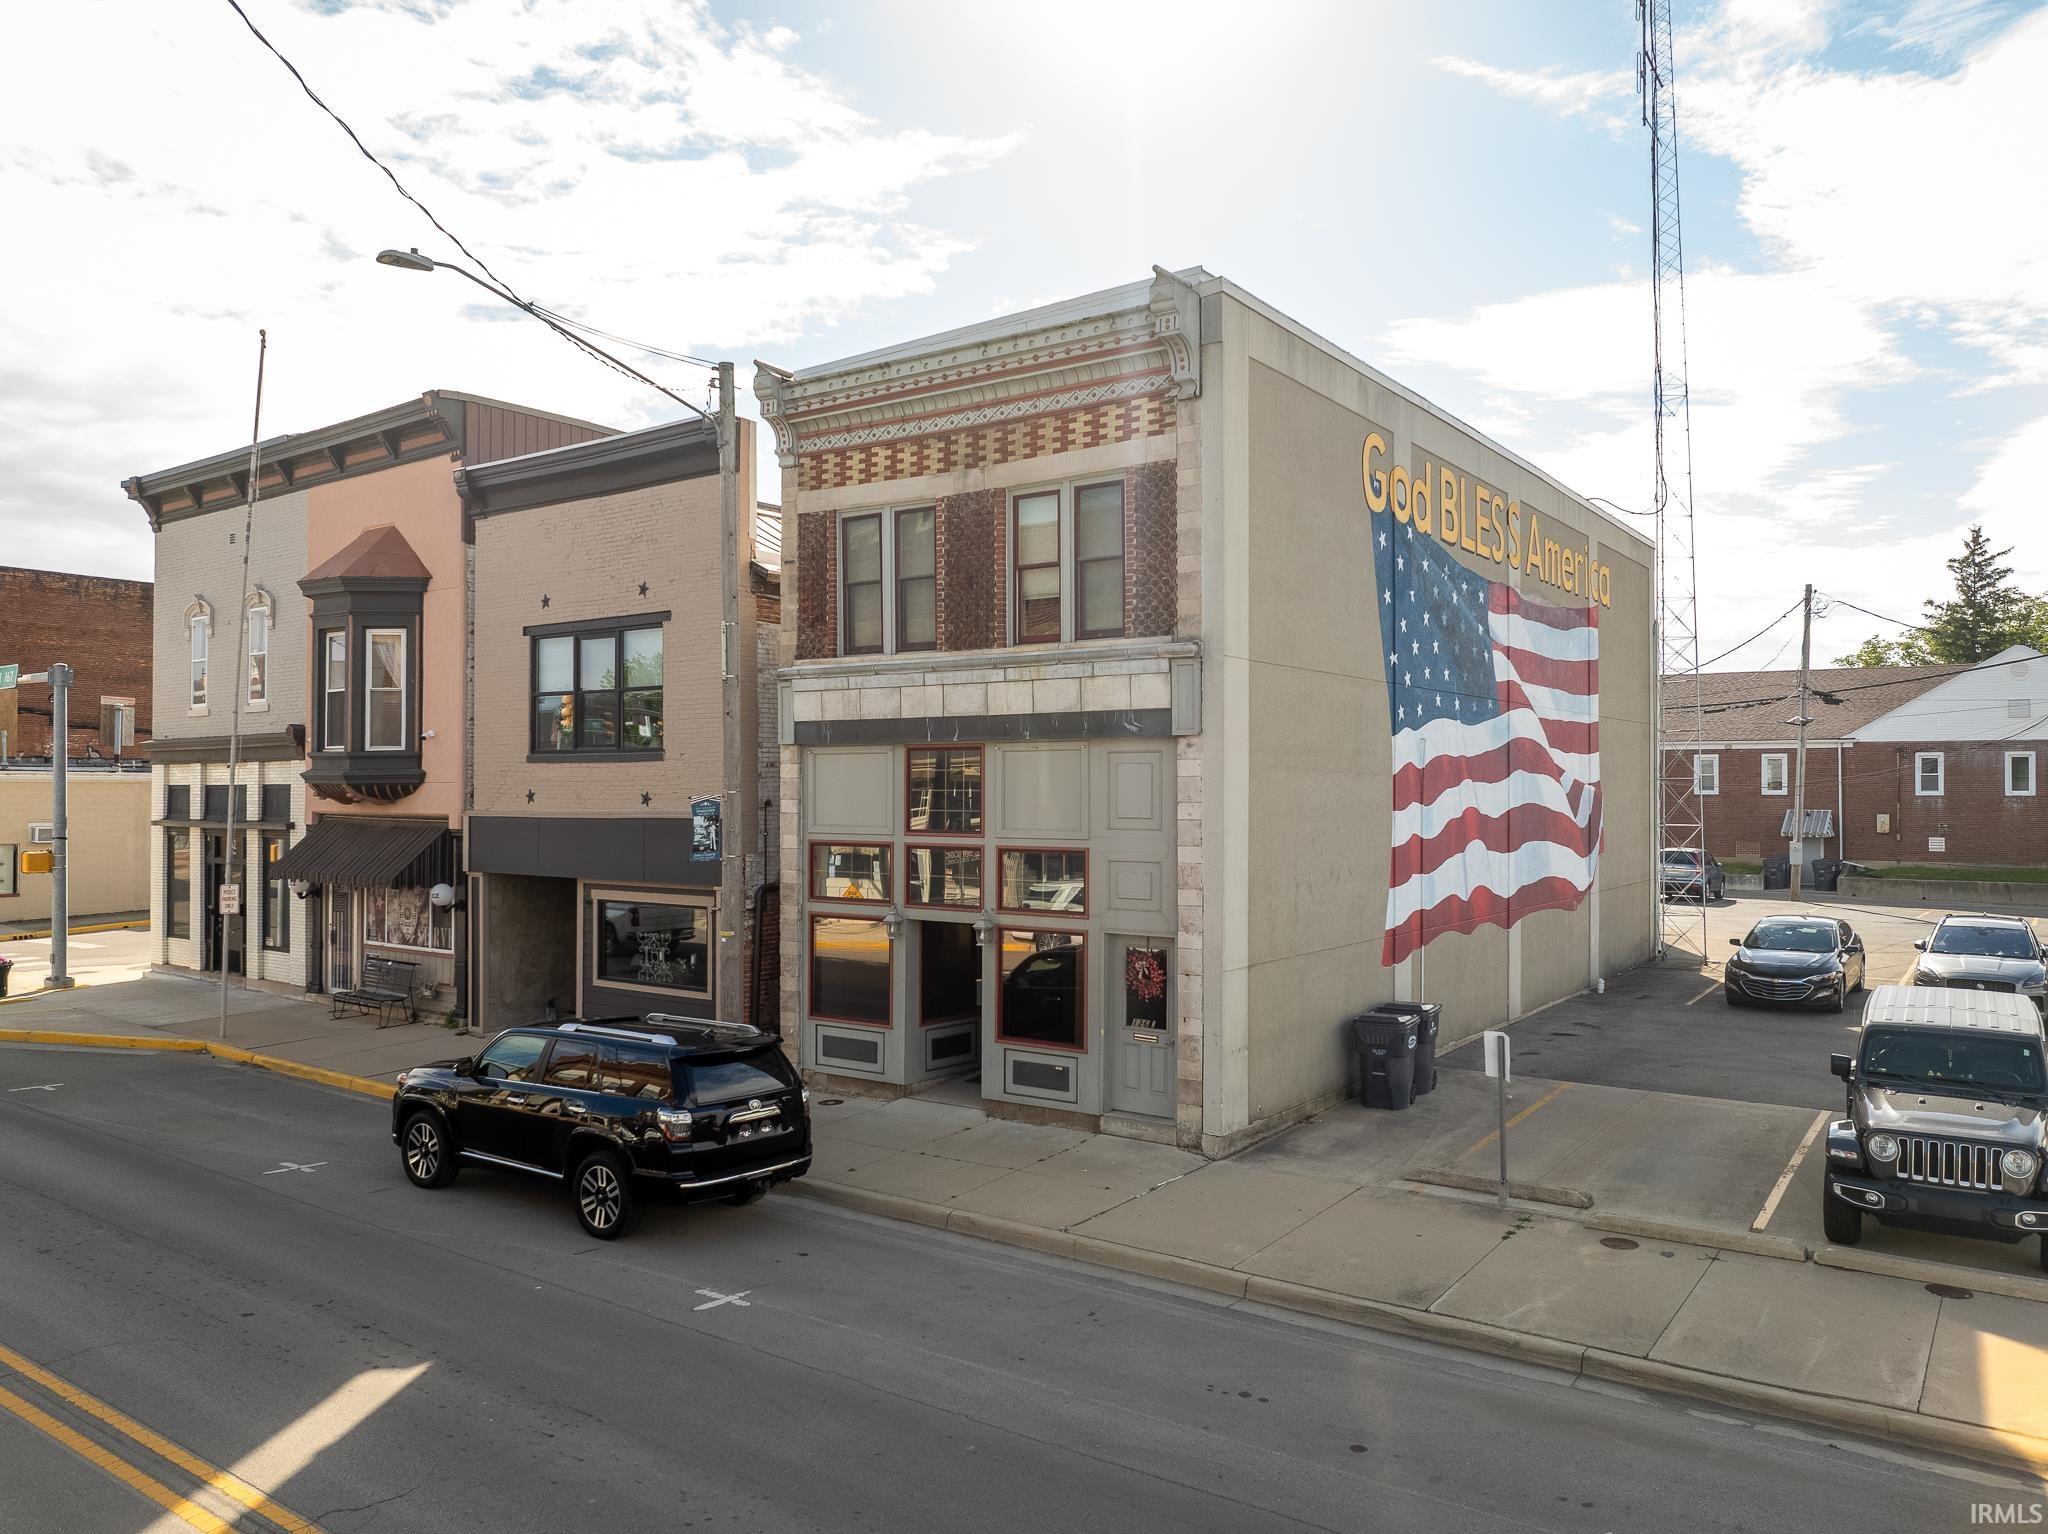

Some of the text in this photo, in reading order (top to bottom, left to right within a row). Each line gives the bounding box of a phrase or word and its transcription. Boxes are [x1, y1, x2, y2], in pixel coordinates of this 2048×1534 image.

[1362, 431, 1612, 608] God BLESS America
